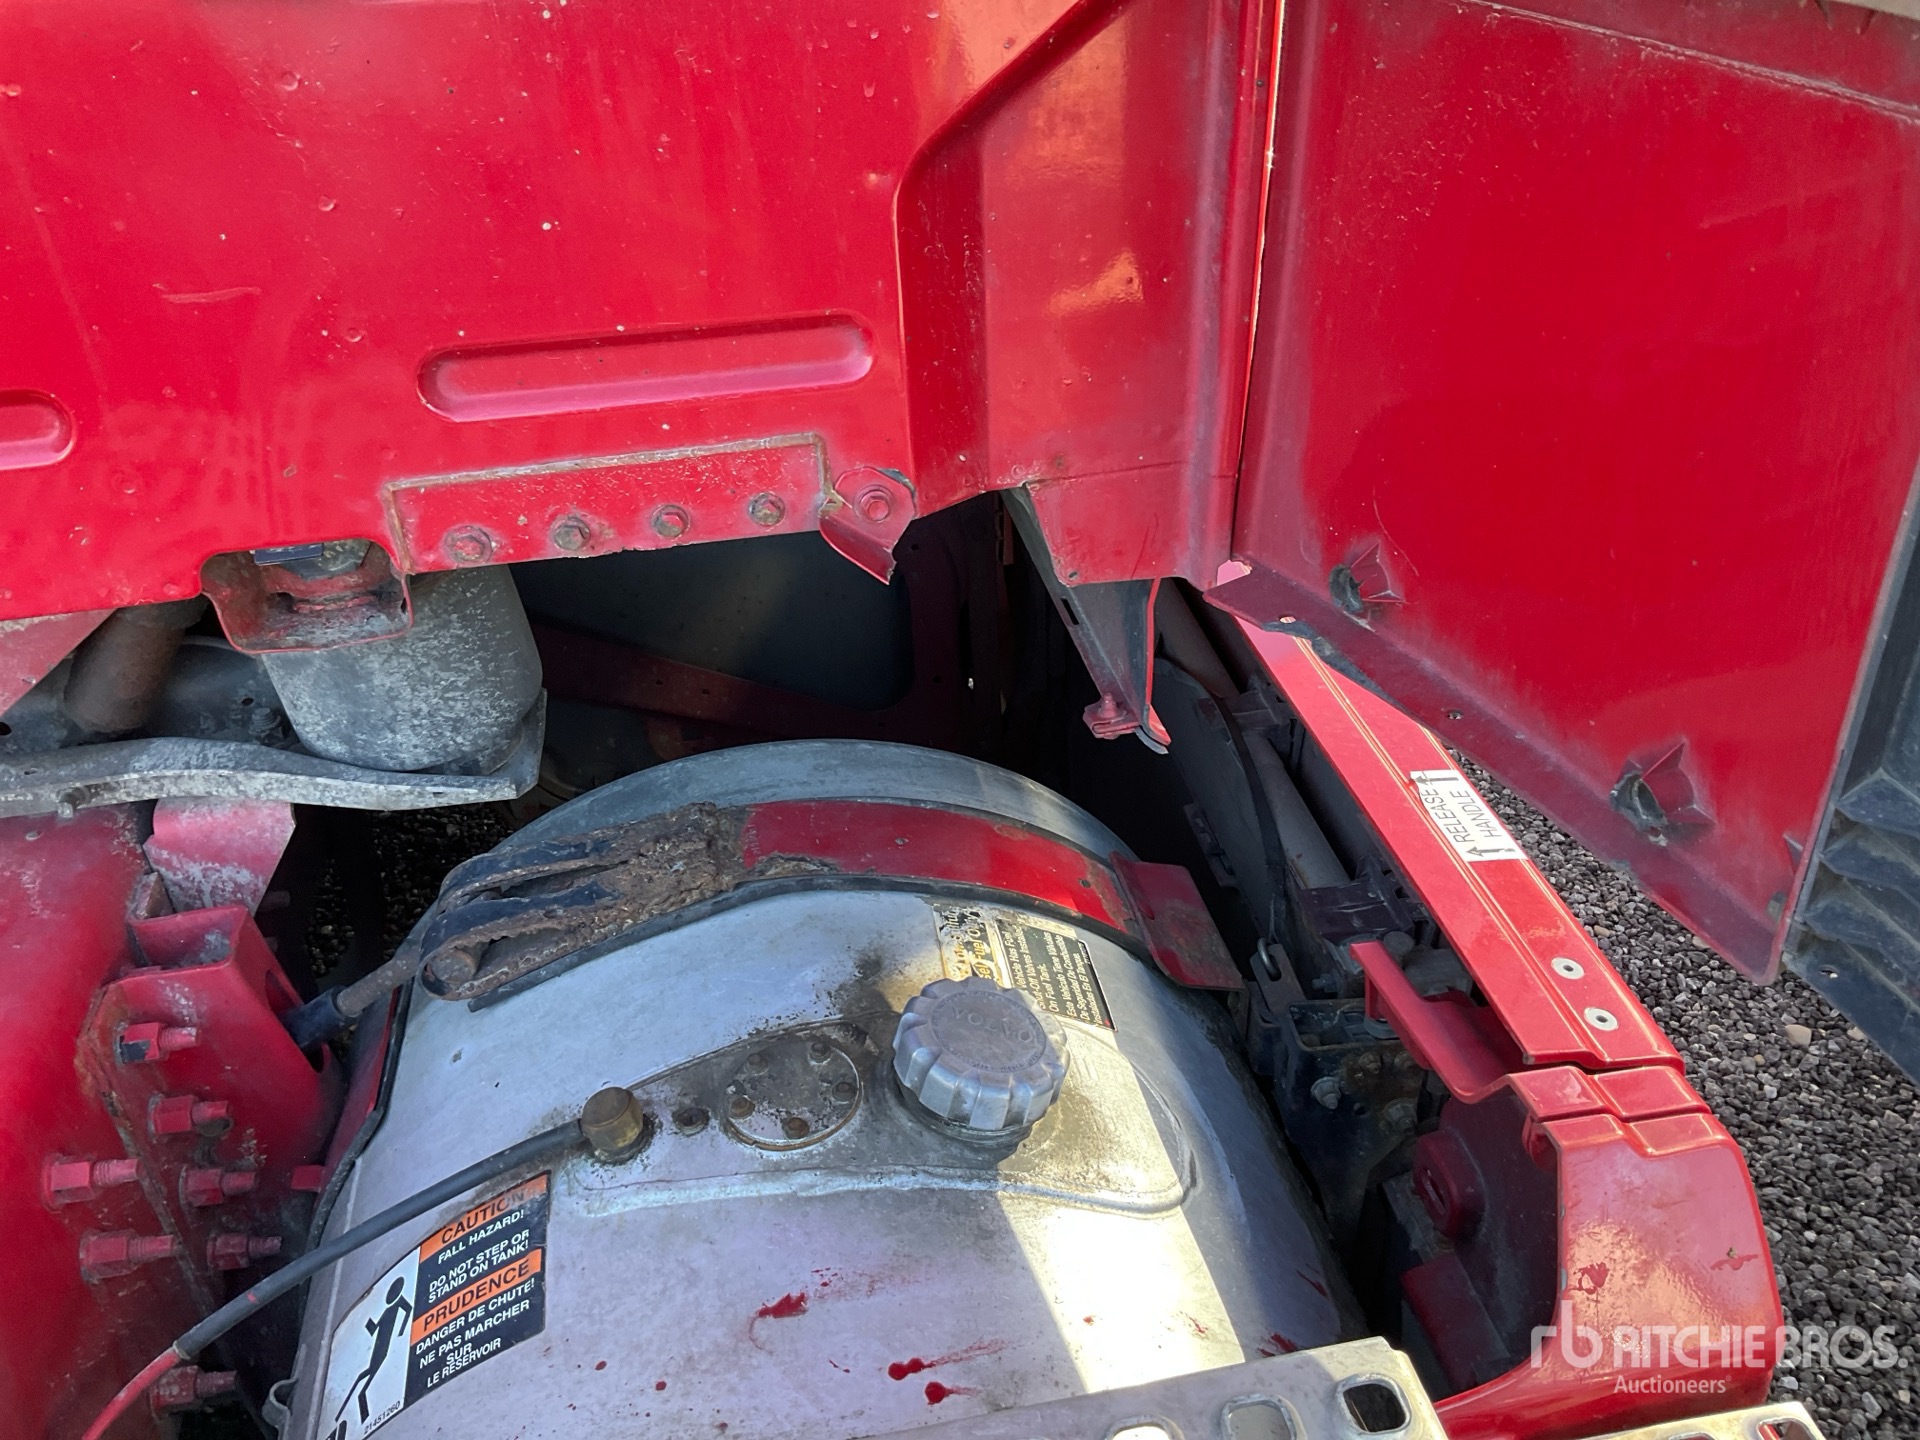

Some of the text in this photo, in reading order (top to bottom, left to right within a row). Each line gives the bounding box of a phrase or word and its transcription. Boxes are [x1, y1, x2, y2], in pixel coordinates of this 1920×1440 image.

[1420, 788, 1475, 843] RELEASE
[1450, 790, 1502, 838] HANDLE
[1002, 931, 1014, 946] Fuel
[1055, 934, 1073, 970] Combustible
[1009, 951, 1020, 962] Has
[1024, 954, 1036, 977] Valves
[1052, 956, 1063, 973] Tiene
[1042, 982, 1055, 999] Fuel
[1049, 1001, 1059, 1012] On
[1071, 979, 1087, 1010] Seguridad
[951, 1001, 1033, 1042] VOLVO
[1065, 1001, 1077, 1017] Este
[1080, 1011, 1090, 1020] De
[441, 1191, 524, 1244] CAUTION
[438, 1209, 524, 1264] FALL HAZARD!
[428, 1239, 529, 1303] STAND ON TANK!
[429, 1229, 530, 1292] DO NOT STEP OR
[423, 1258, 530, 1332] PRUDENCE
[416, 1277, 535, 1355] DANGER DE CHUTE!
[419, 1299, 530, 1369] NE PAS MARCHER
[446, 1342, 473, 1365] SUR
[427, 1371, 440, 1388] LE
